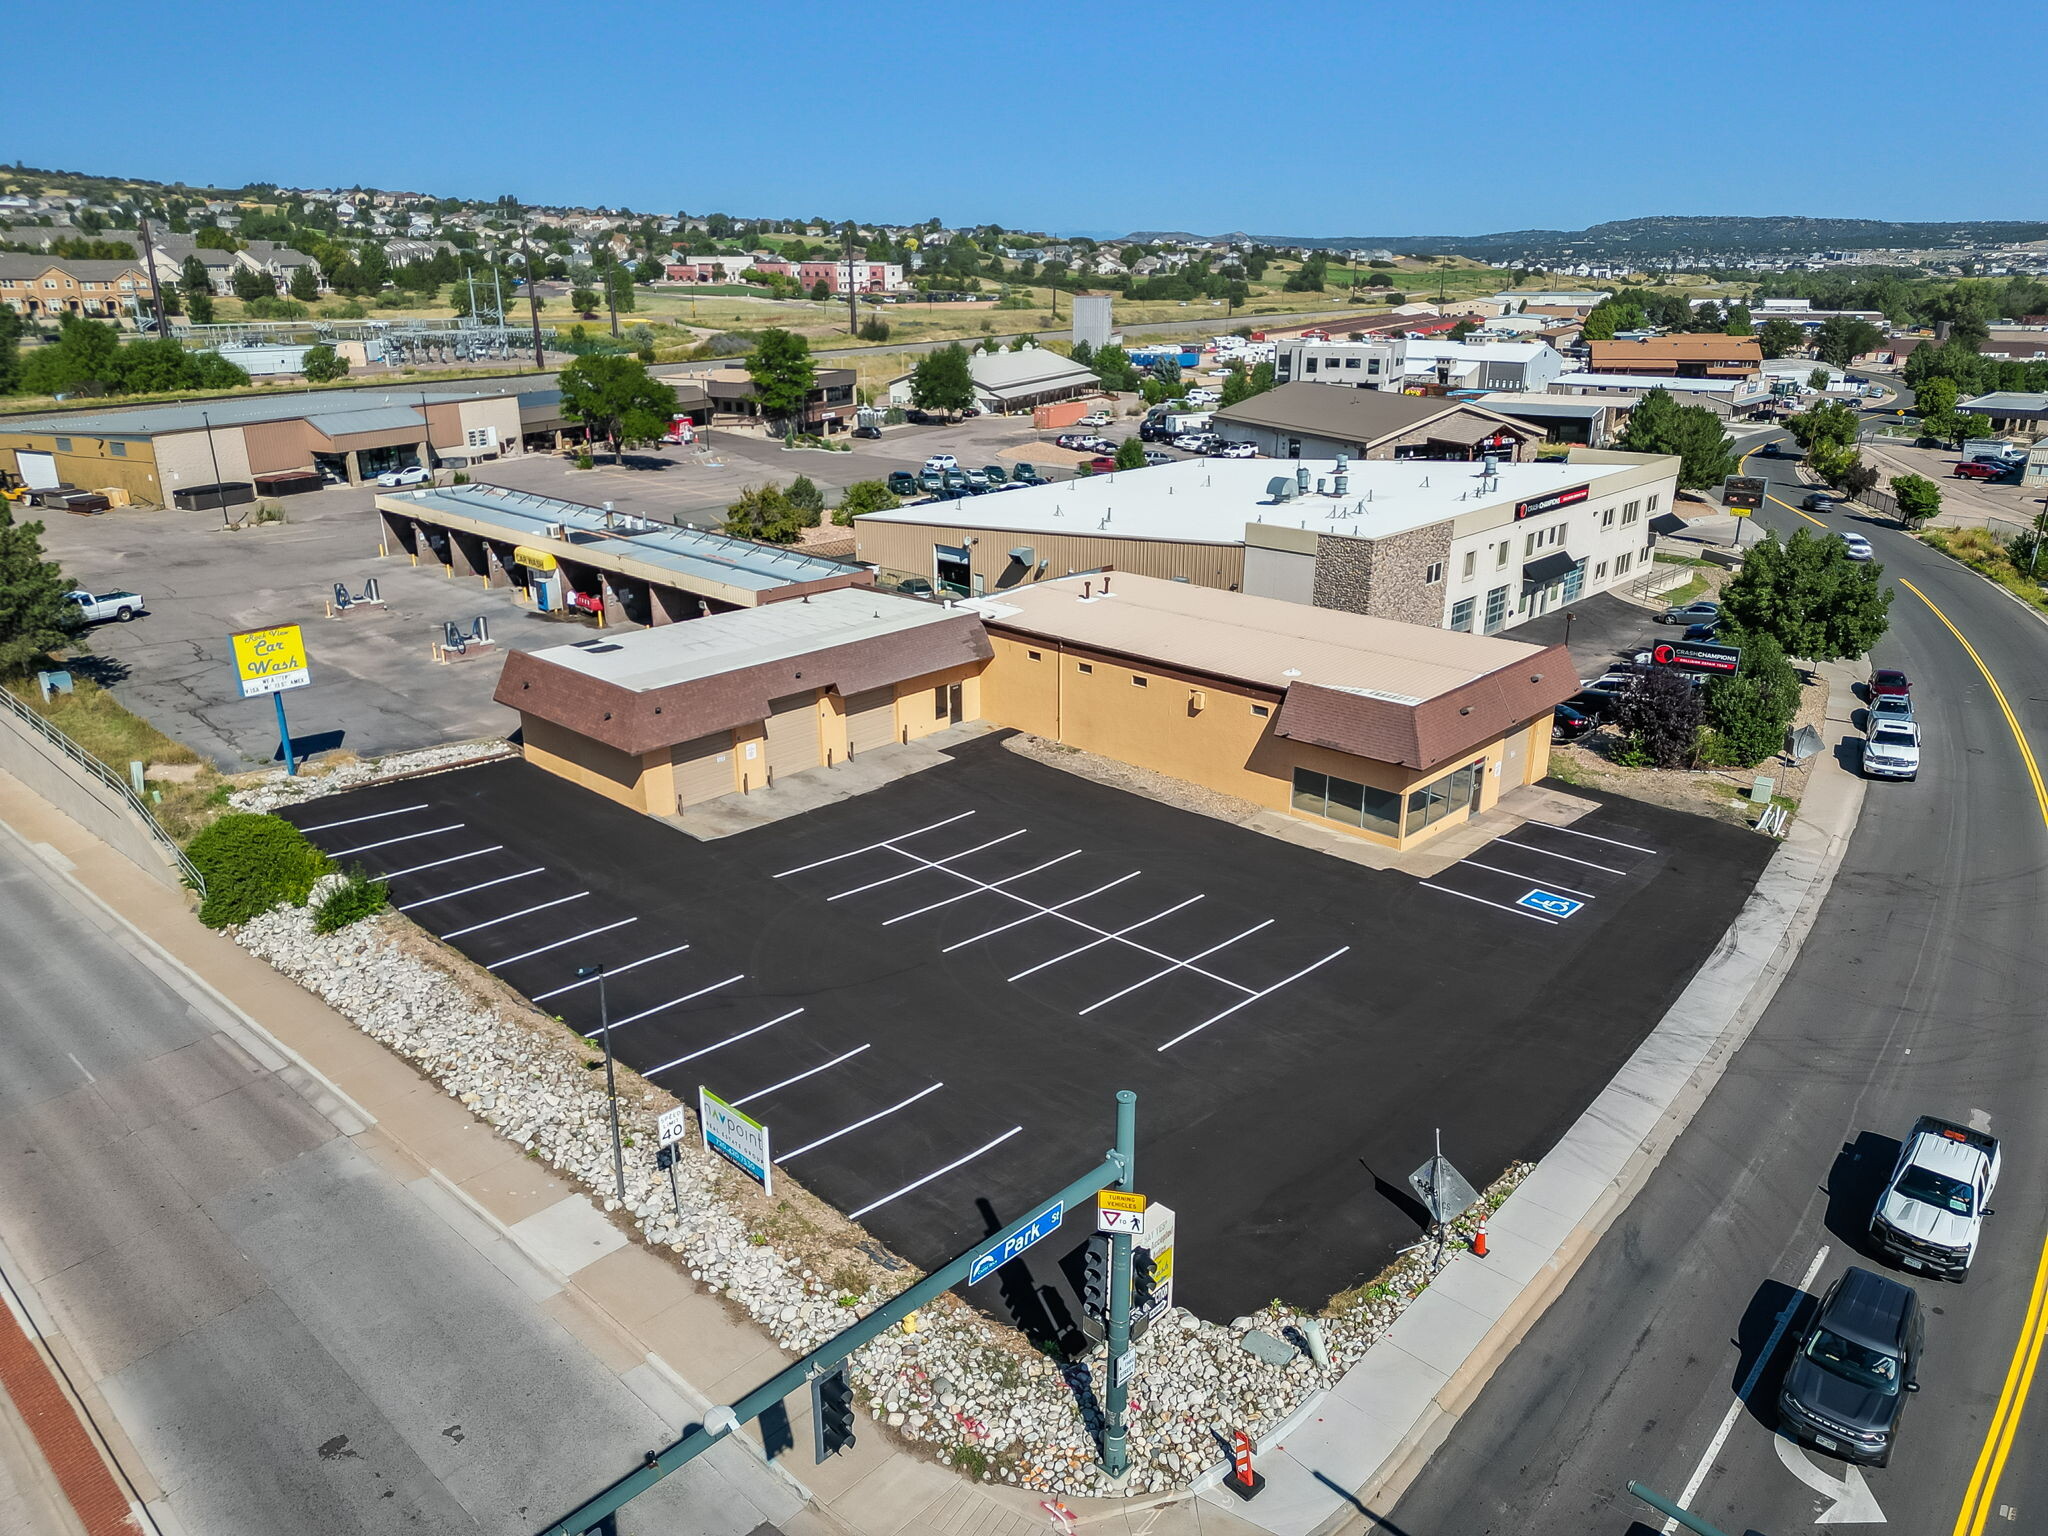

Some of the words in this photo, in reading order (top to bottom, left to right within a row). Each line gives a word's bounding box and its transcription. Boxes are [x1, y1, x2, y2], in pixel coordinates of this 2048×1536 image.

[254, 640, 285, 656] Car
[247, 655, 299, 675] Wash
[661, 1110, 681, 1123] SPEED
[662, 1123, 683, 1140] 40
[1107, 1200, 1137, 1209] VEHICLES
[1109, 1194, 1136, 1203] TURNING
[1004, 1223, 1040, 1259] Park
[1051, 1211, 1060, 1223] St
